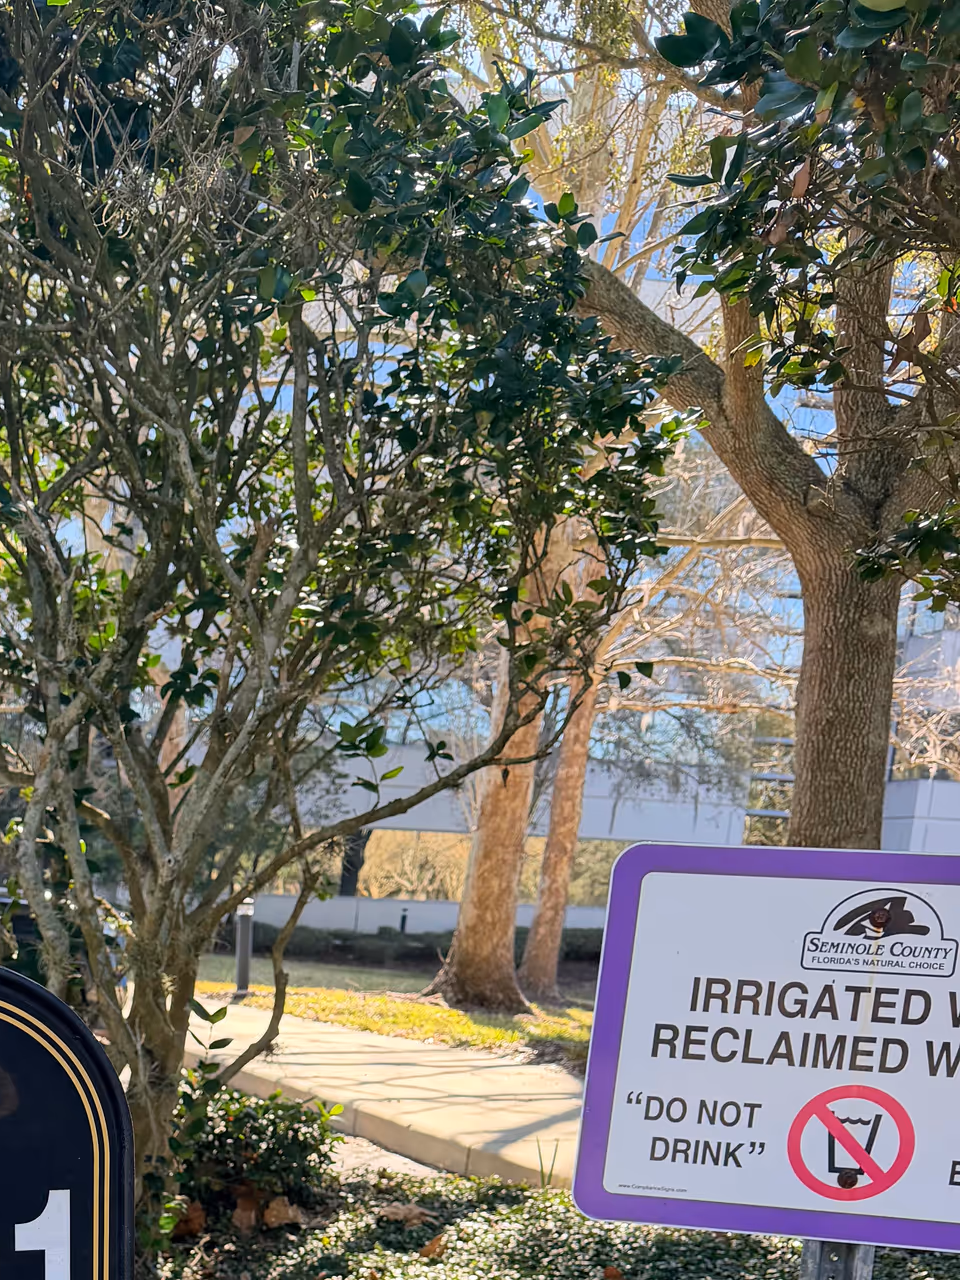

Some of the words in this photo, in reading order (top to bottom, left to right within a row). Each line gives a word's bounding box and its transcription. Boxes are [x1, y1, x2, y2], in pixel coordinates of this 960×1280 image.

[807, 937, 885, 956] SEMINOLE
[890, 941, 953, 960] COUNTY
[811, 955, 860, 966] FLORIDA'S
[862, 959, 906, 969] NATURAL
[908, 961, 945, 971] CHOICE
[690, 977, 932, 1025] IRRIGATED
[651, 1023, 909, 1074] RECLAIMED
[697, 1099, 762, 1129] NOT
